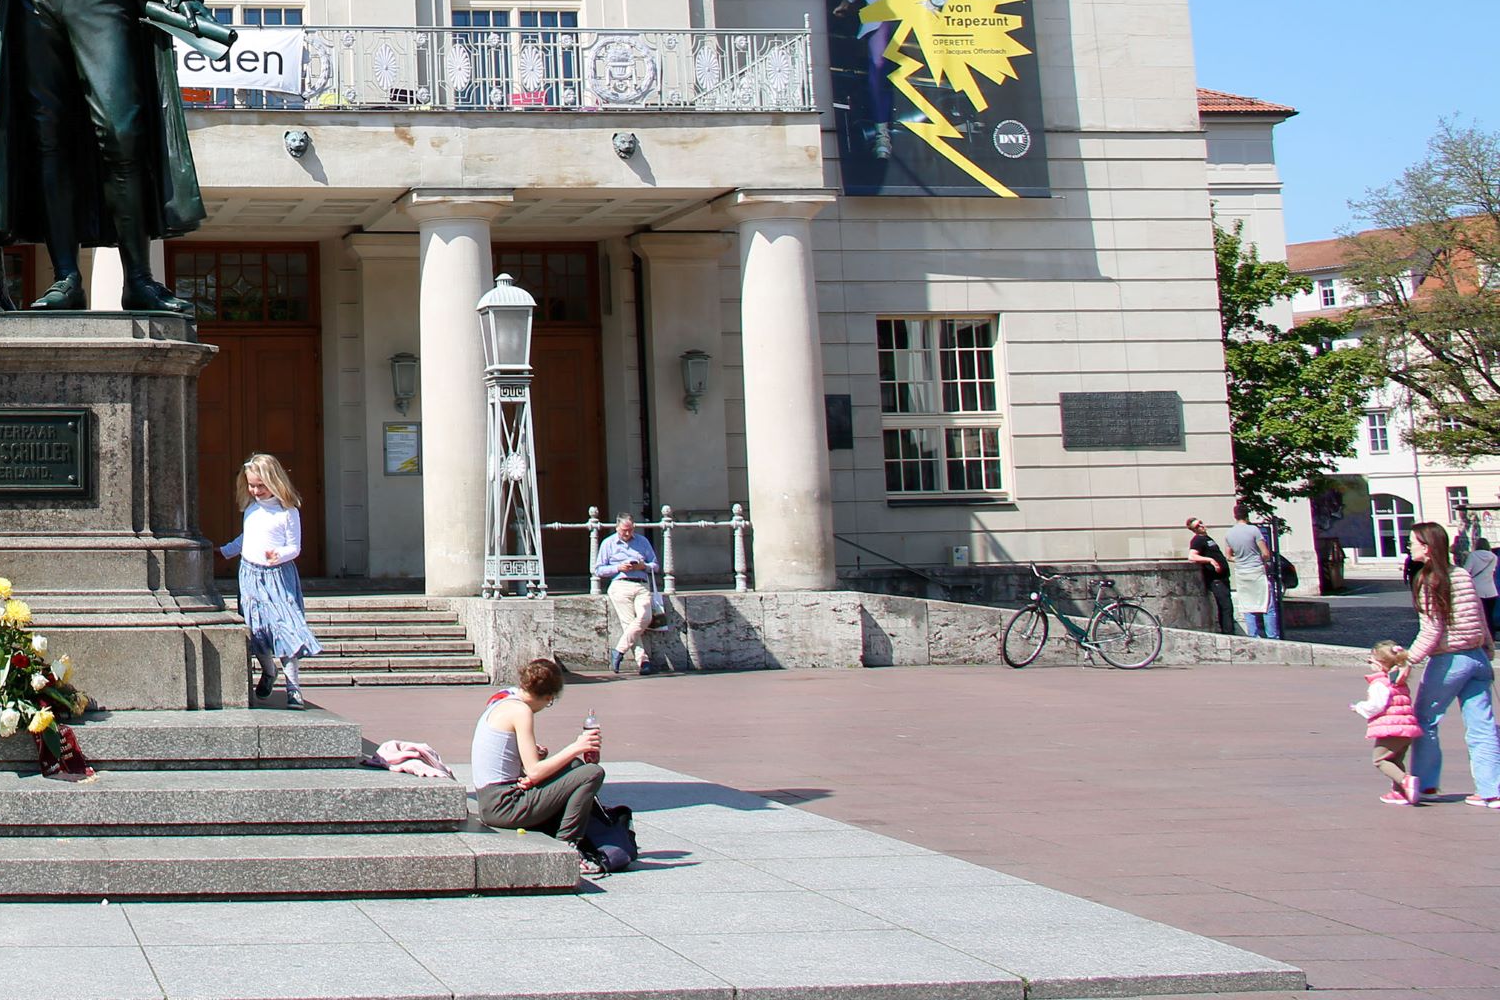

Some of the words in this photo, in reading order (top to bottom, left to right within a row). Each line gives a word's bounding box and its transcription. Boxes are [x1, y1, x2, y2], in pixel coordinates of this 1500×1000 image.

[948, 4, 972, 13] von
[944, 15, 1009, 28] Trapezunt
[999, 134, 1026, 144] DNT
[0, 442, 73, 464] SCHILLER
